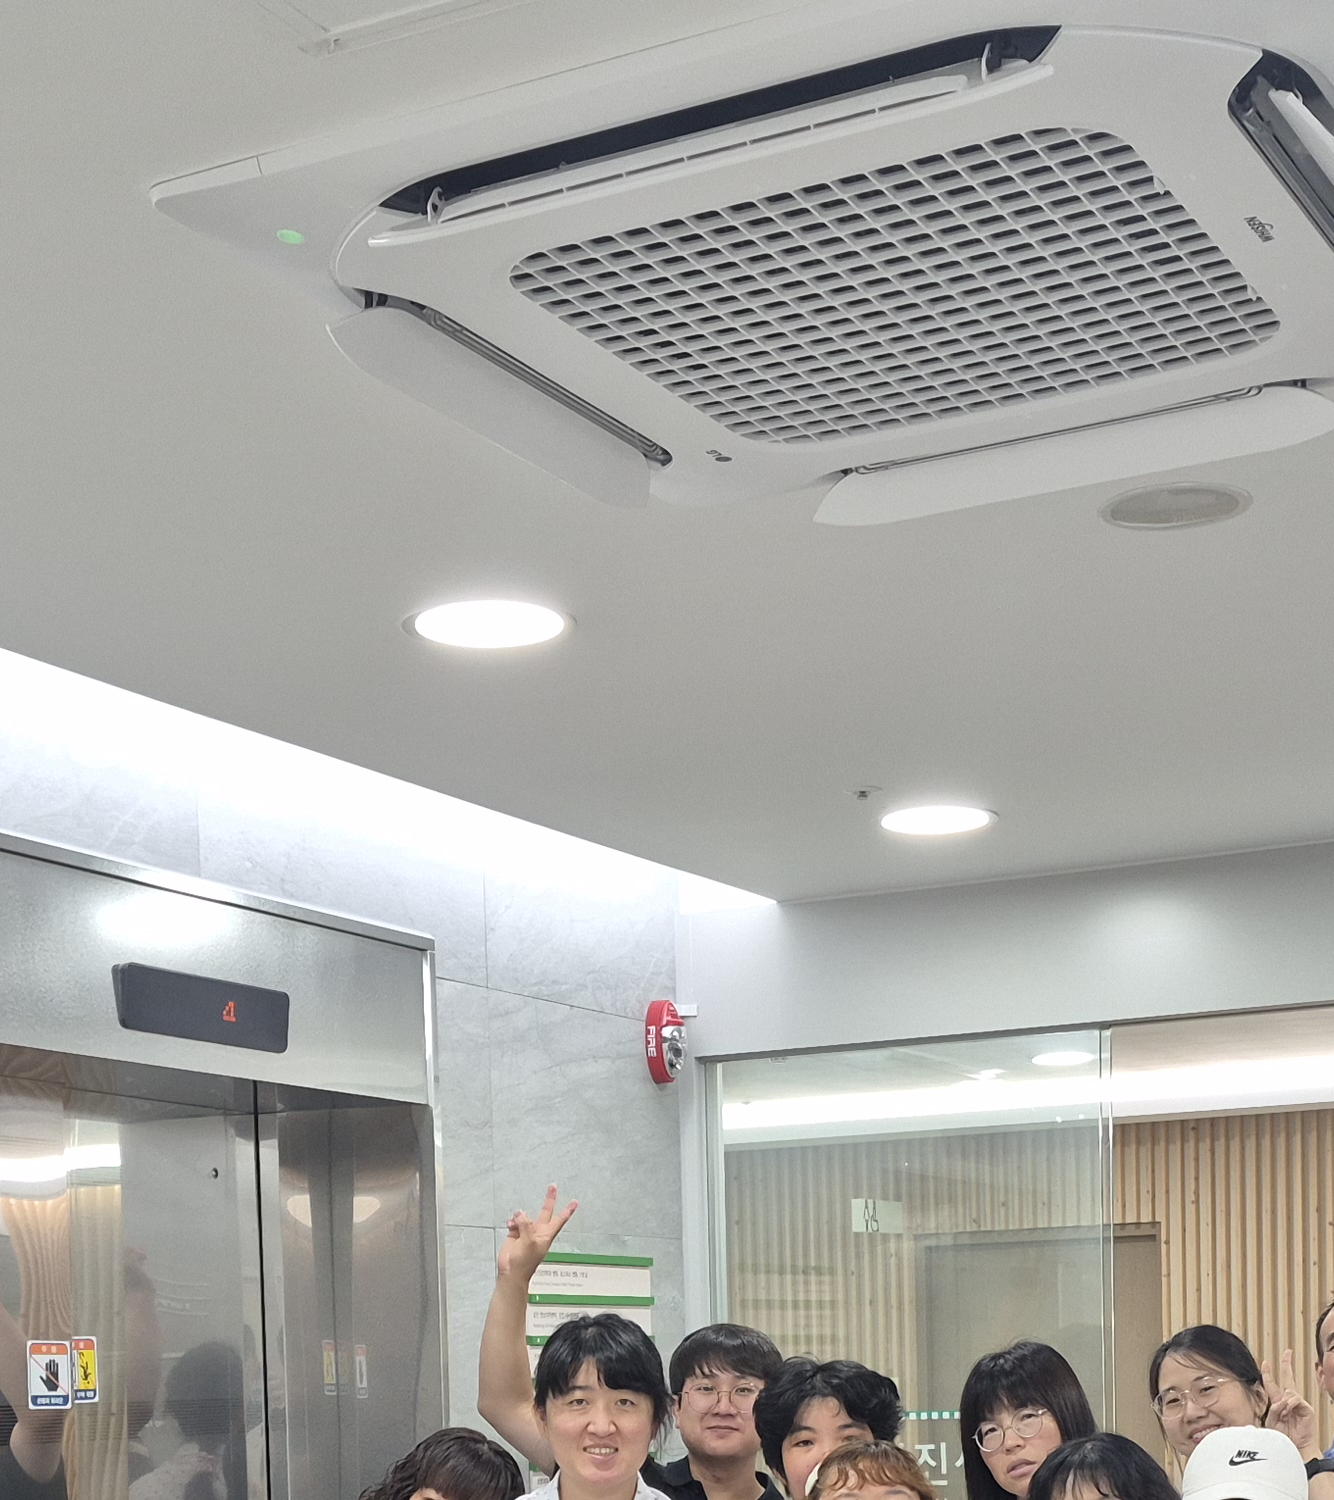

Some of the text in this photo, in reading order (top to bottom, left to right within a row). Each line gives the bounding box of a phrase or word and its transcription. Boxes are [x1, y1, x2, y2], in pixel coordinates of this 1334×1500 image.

[222, 1001, 236, 1022] 4
[646, 1025, 657, 1058] FIRE
[1234, 1449, 1260, 1460] NIKE
